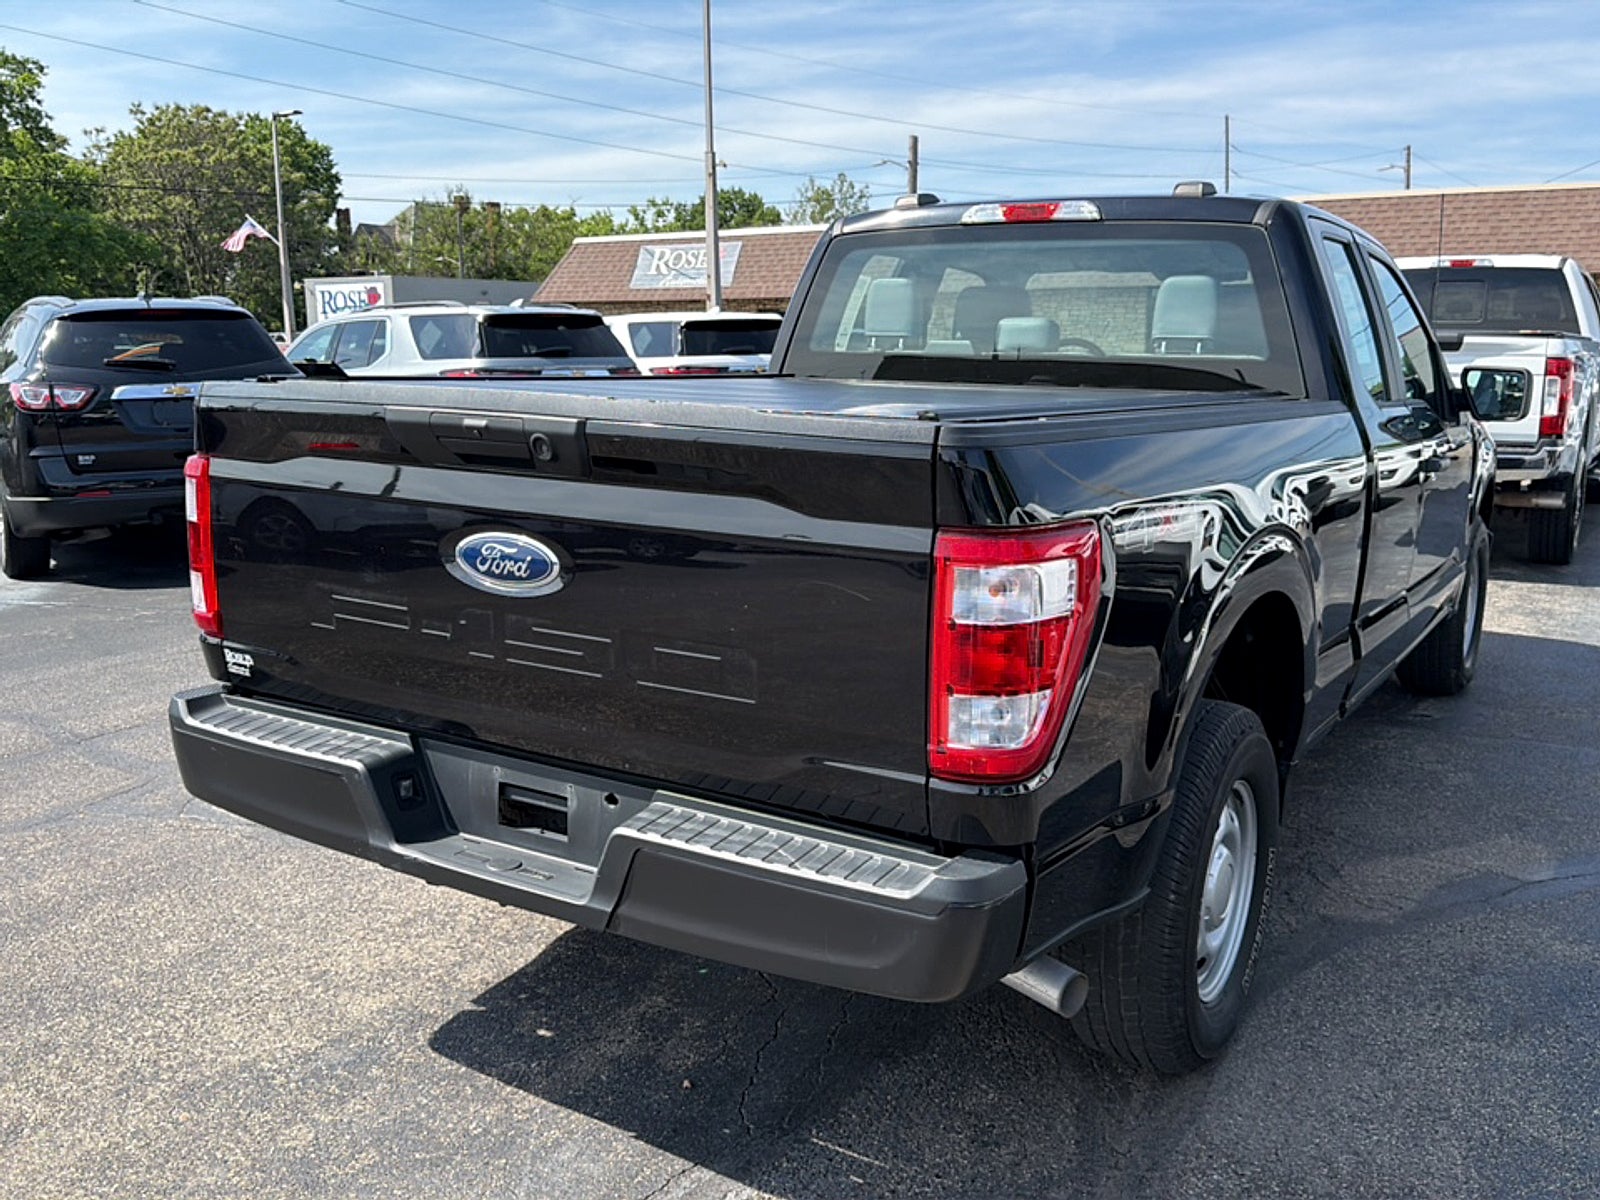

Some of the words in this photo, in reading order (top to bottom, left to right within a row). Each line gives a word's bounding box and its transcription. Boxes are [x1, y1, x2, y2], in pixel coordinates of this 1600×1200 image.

[647, 248, 708, 275] ROSE
[319, 289, 367, 314] ROSE
[477, 543, 532, 578] Ford
